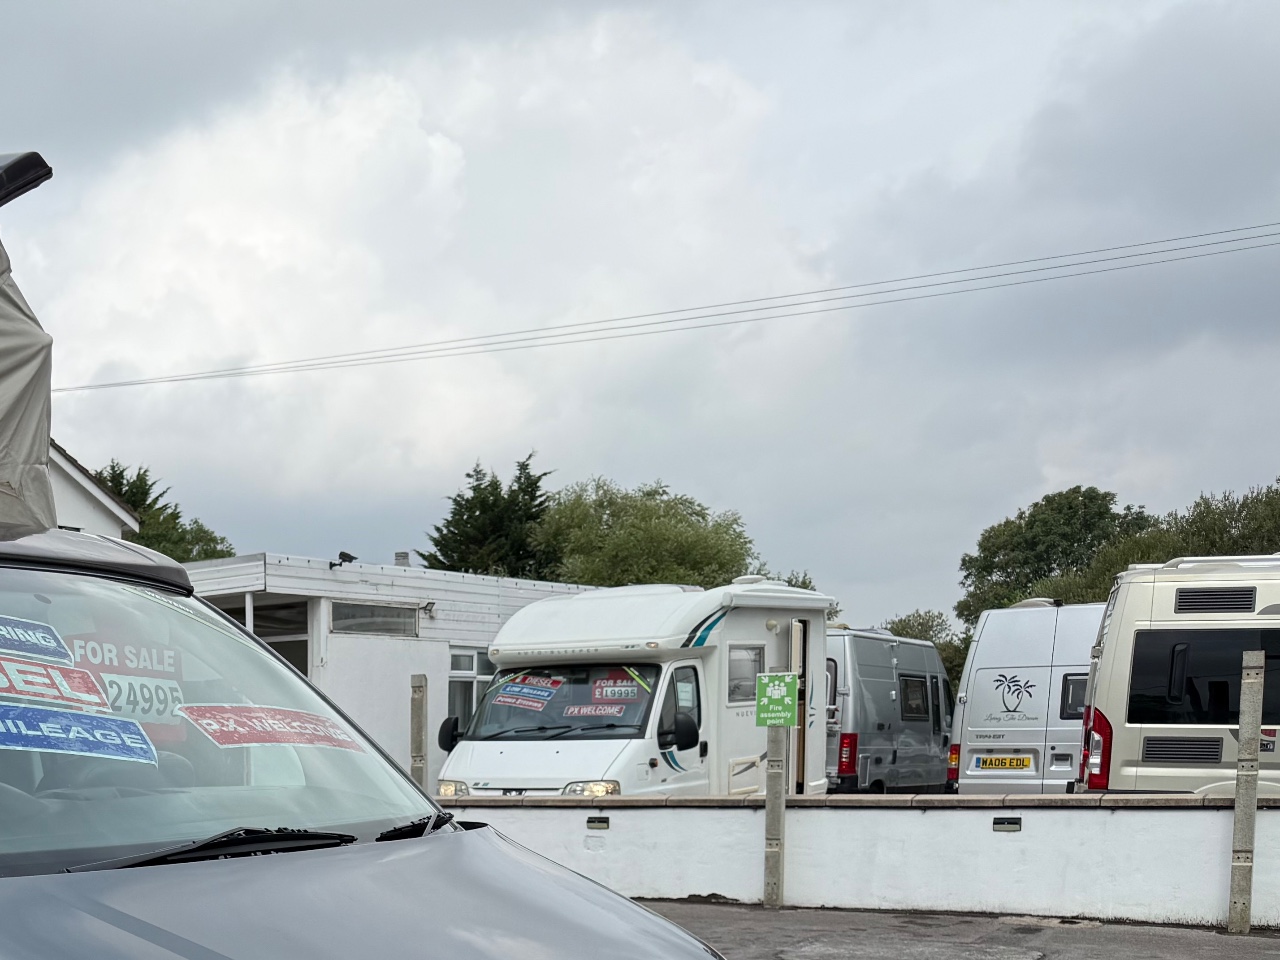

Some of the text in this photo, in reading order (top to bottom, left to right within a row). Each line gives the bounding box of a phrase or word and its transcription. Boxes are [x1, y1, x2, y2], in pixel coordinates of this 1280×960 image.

[73, 639, 176, 673] FOR SALE
[525, 676, 554, 687] DIESEL
[595, 679, 614, 687] FOR
[108, 679, 184, 718] 24995
[580, 706, 620, 715] WELCOME
[736, 710, 756, 718] NUEV
[760, 711, 792, 719] assembly
[766, 718, 785, 726] point
[250, 718, 352, 742] WELCOME
[1008, 758, 1028, 767] EDL
